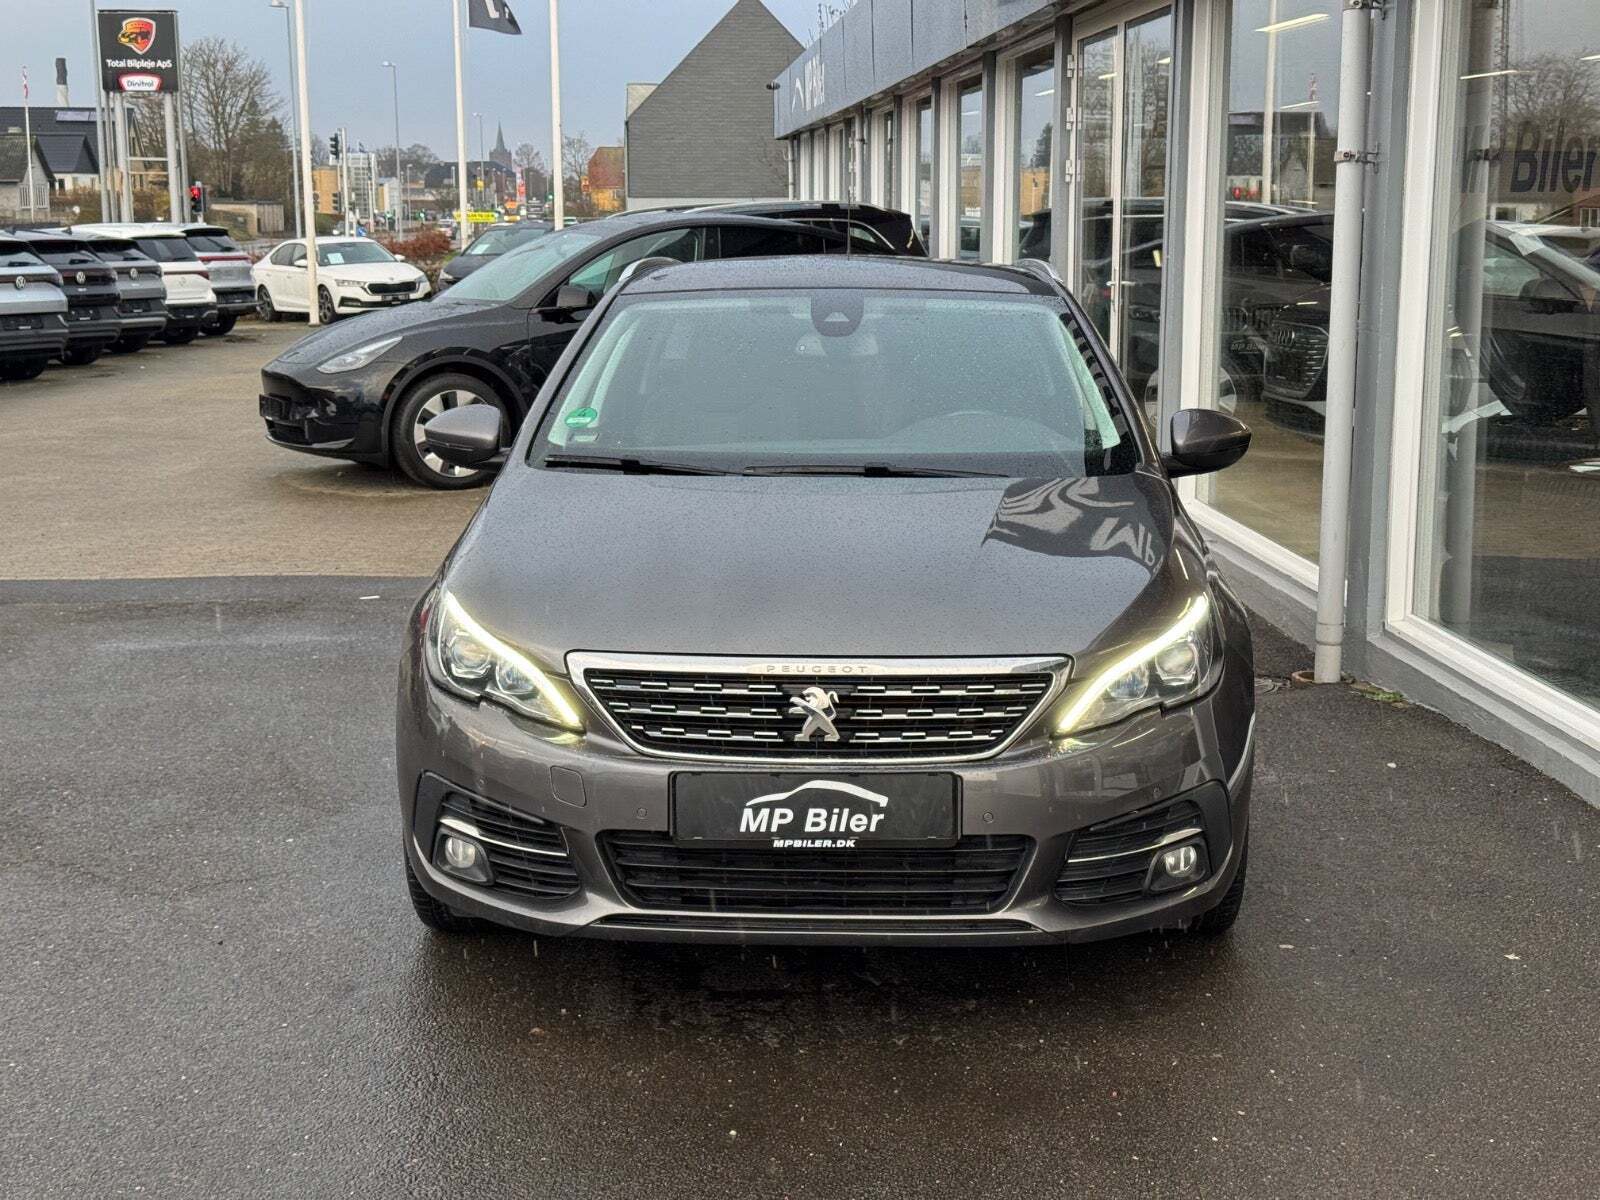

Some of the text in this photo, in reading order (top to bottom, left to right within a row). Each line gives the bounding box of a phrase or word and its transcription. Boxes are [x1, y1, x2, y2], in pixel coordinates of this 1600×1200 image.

[106, 59, 172, 69] Total Bilpleje ApS
[126, 79, 154, 88] Dinitrol
[1510, 120, 1600, 195] Biler
[766, 665, 868, 673] PEUGEOT
[739, 807, 885, 833] MP Biler
[773, 839, 856, 848] MPBILER.DK
